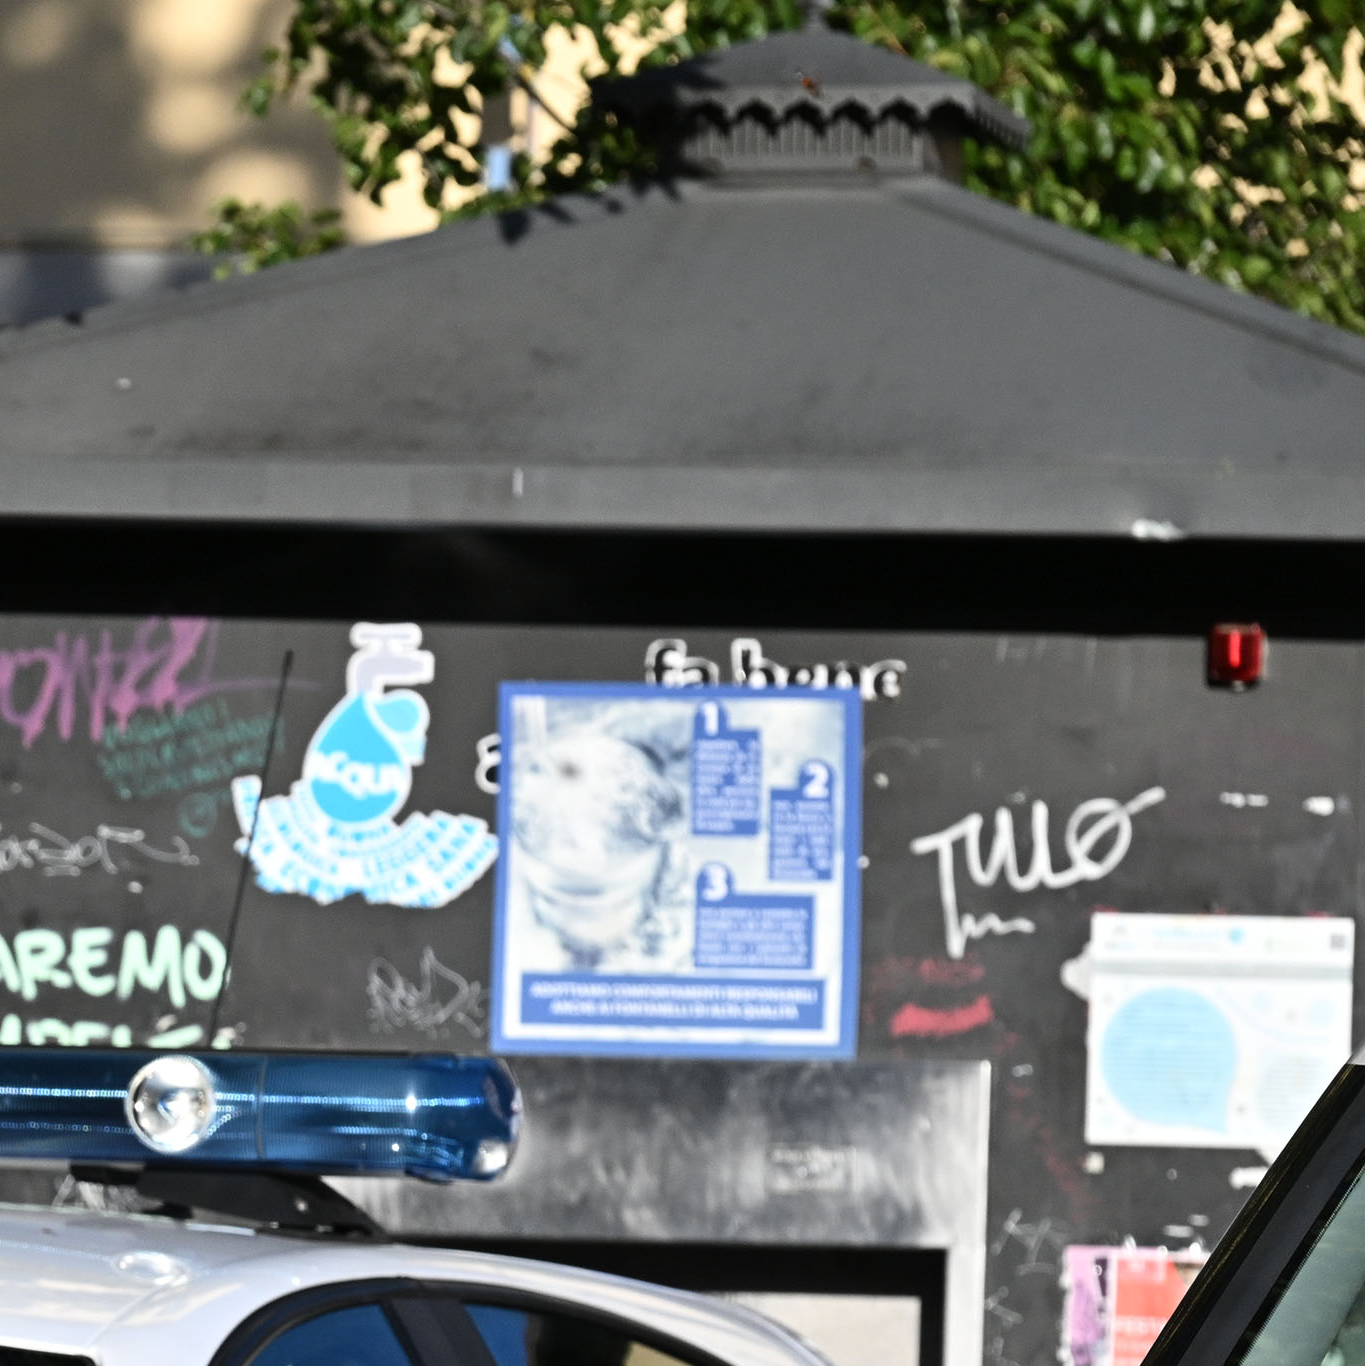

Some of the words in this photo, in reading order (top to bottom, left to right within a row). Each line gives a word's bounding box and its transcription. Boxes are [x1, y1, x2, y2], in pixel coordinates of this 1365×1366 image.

[699, 700, 719, 737] 1
[801, 761, 830, 799] 2
[701, 862, 729, 902] 3
